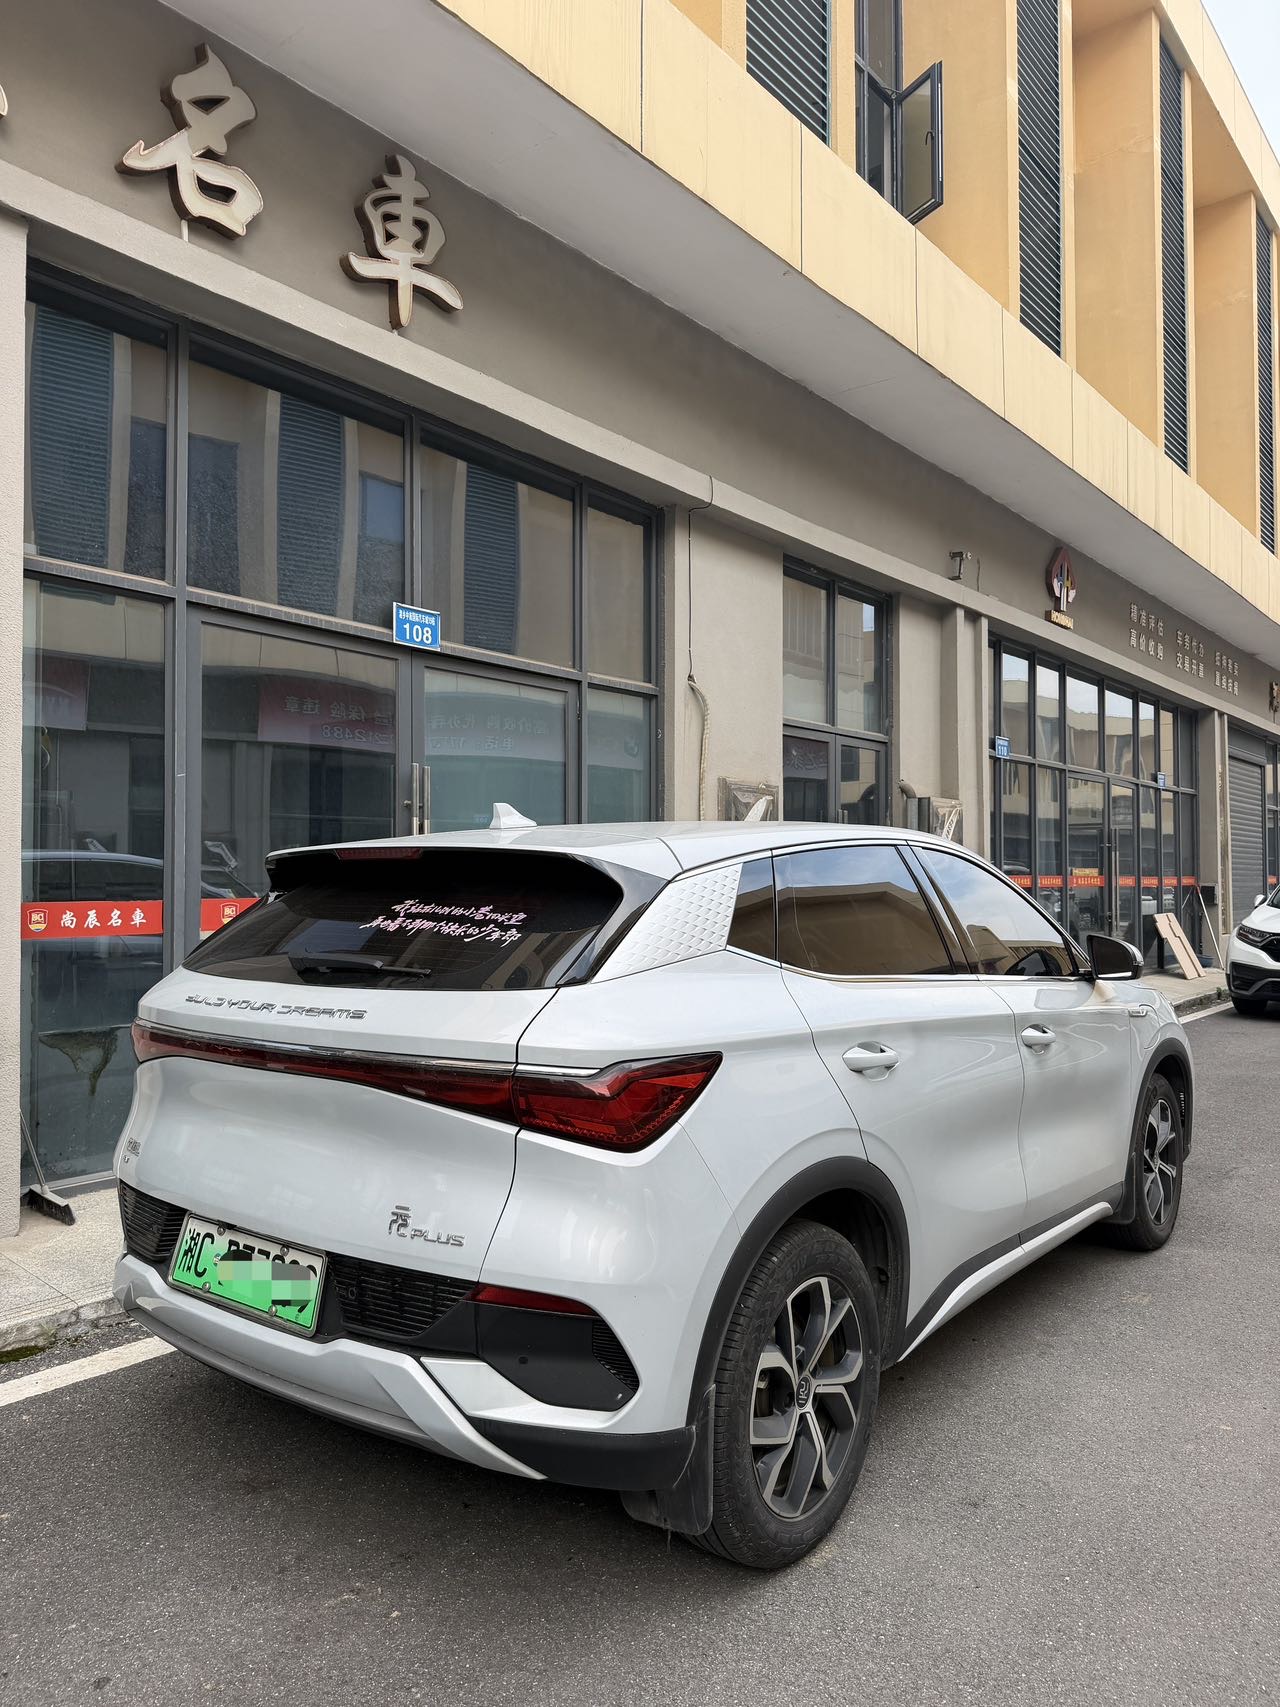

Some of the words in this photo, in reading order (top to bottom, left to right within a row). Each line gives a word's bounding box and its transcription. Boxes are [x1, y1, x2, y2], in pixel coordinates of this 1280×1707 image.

[0, 43, 463, 330] 名車
[403, 622, 432, 644] 108
[61, 908, 147, 929] 尚辰名車
[277, 1005, 367, 1019] DREAMS
[410, 1228, 465, 1247] PLUS
